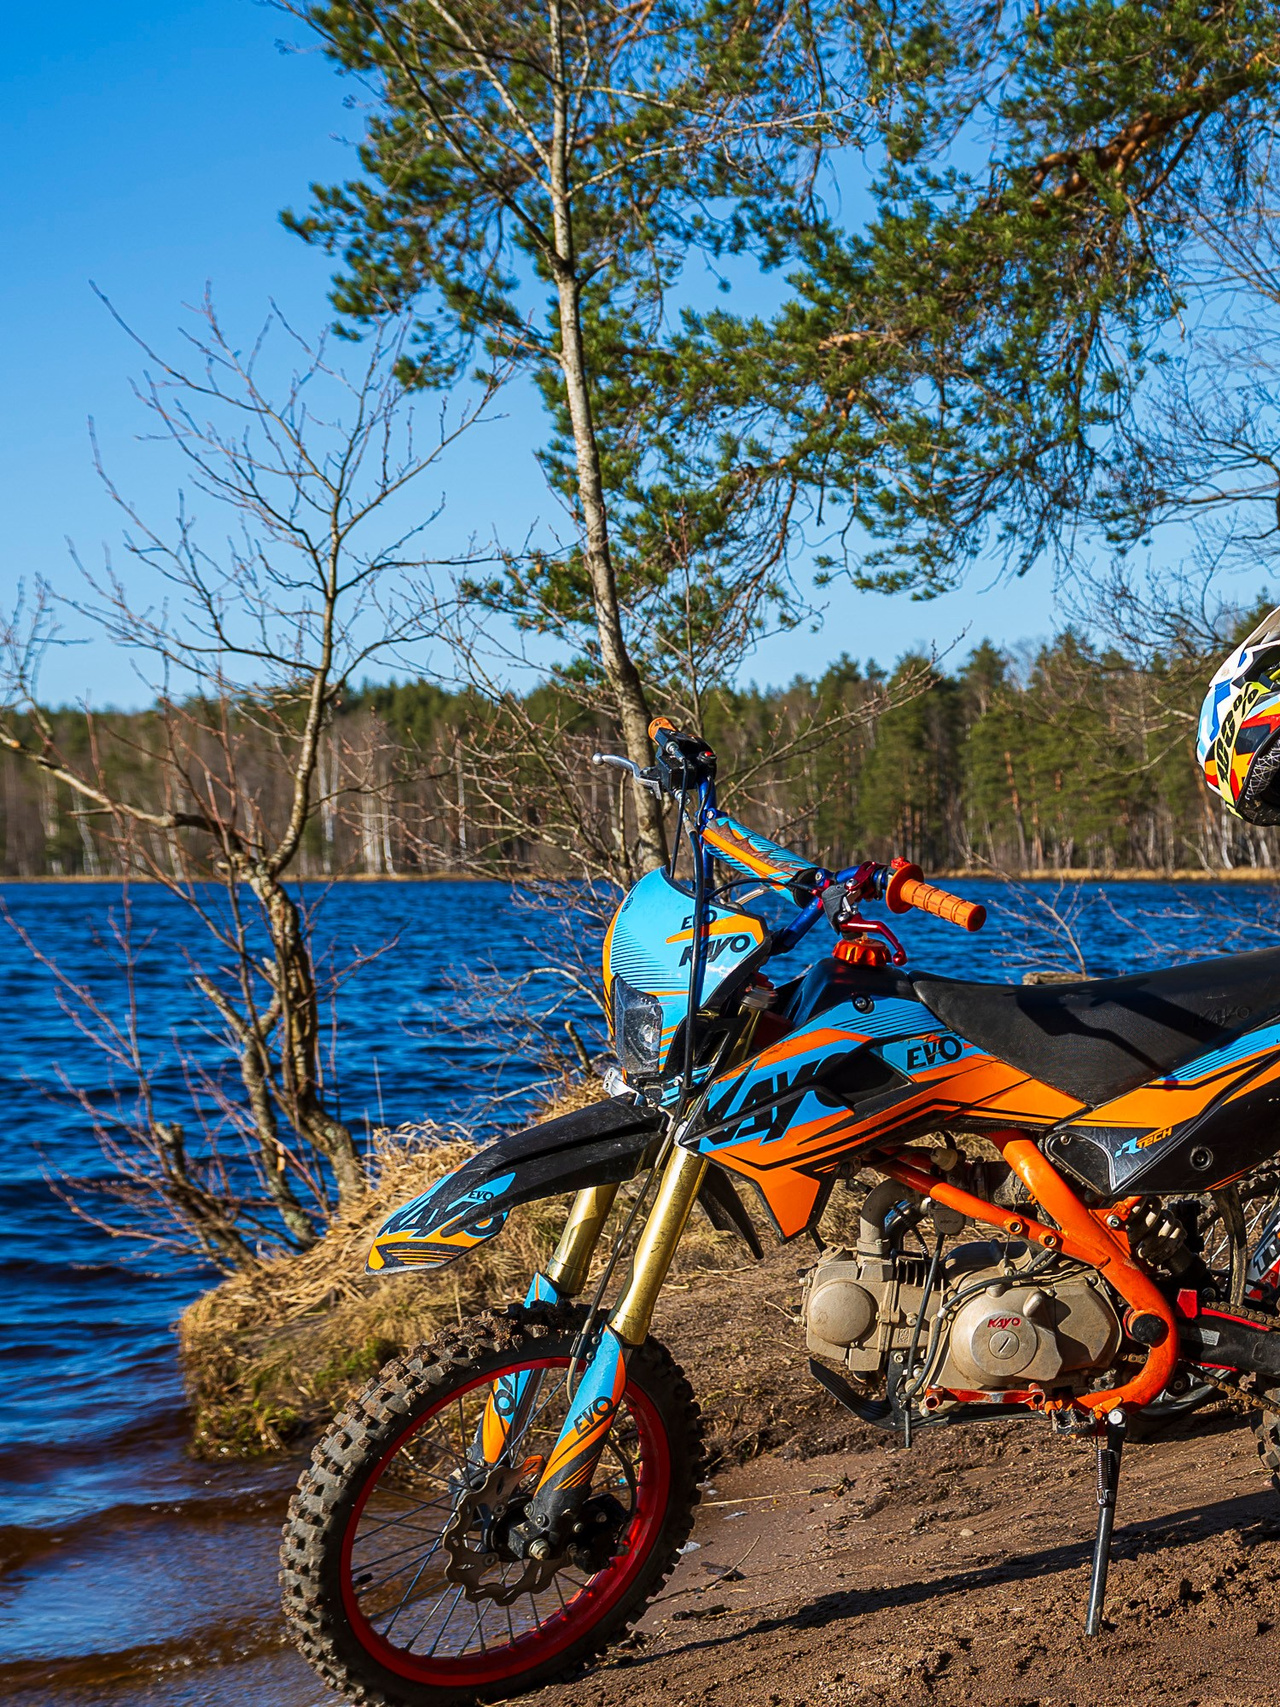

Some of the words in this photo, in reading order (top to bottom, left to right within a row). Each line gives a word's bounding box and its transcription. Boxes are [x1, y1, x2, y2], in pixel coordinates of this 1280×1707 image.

[681, 910, 717, 930] EO
[906, 1035, 963, 1071] EVO
[468, 1190, 494, 1201] EVO
[574, 1396, 613, 1435] EVO
